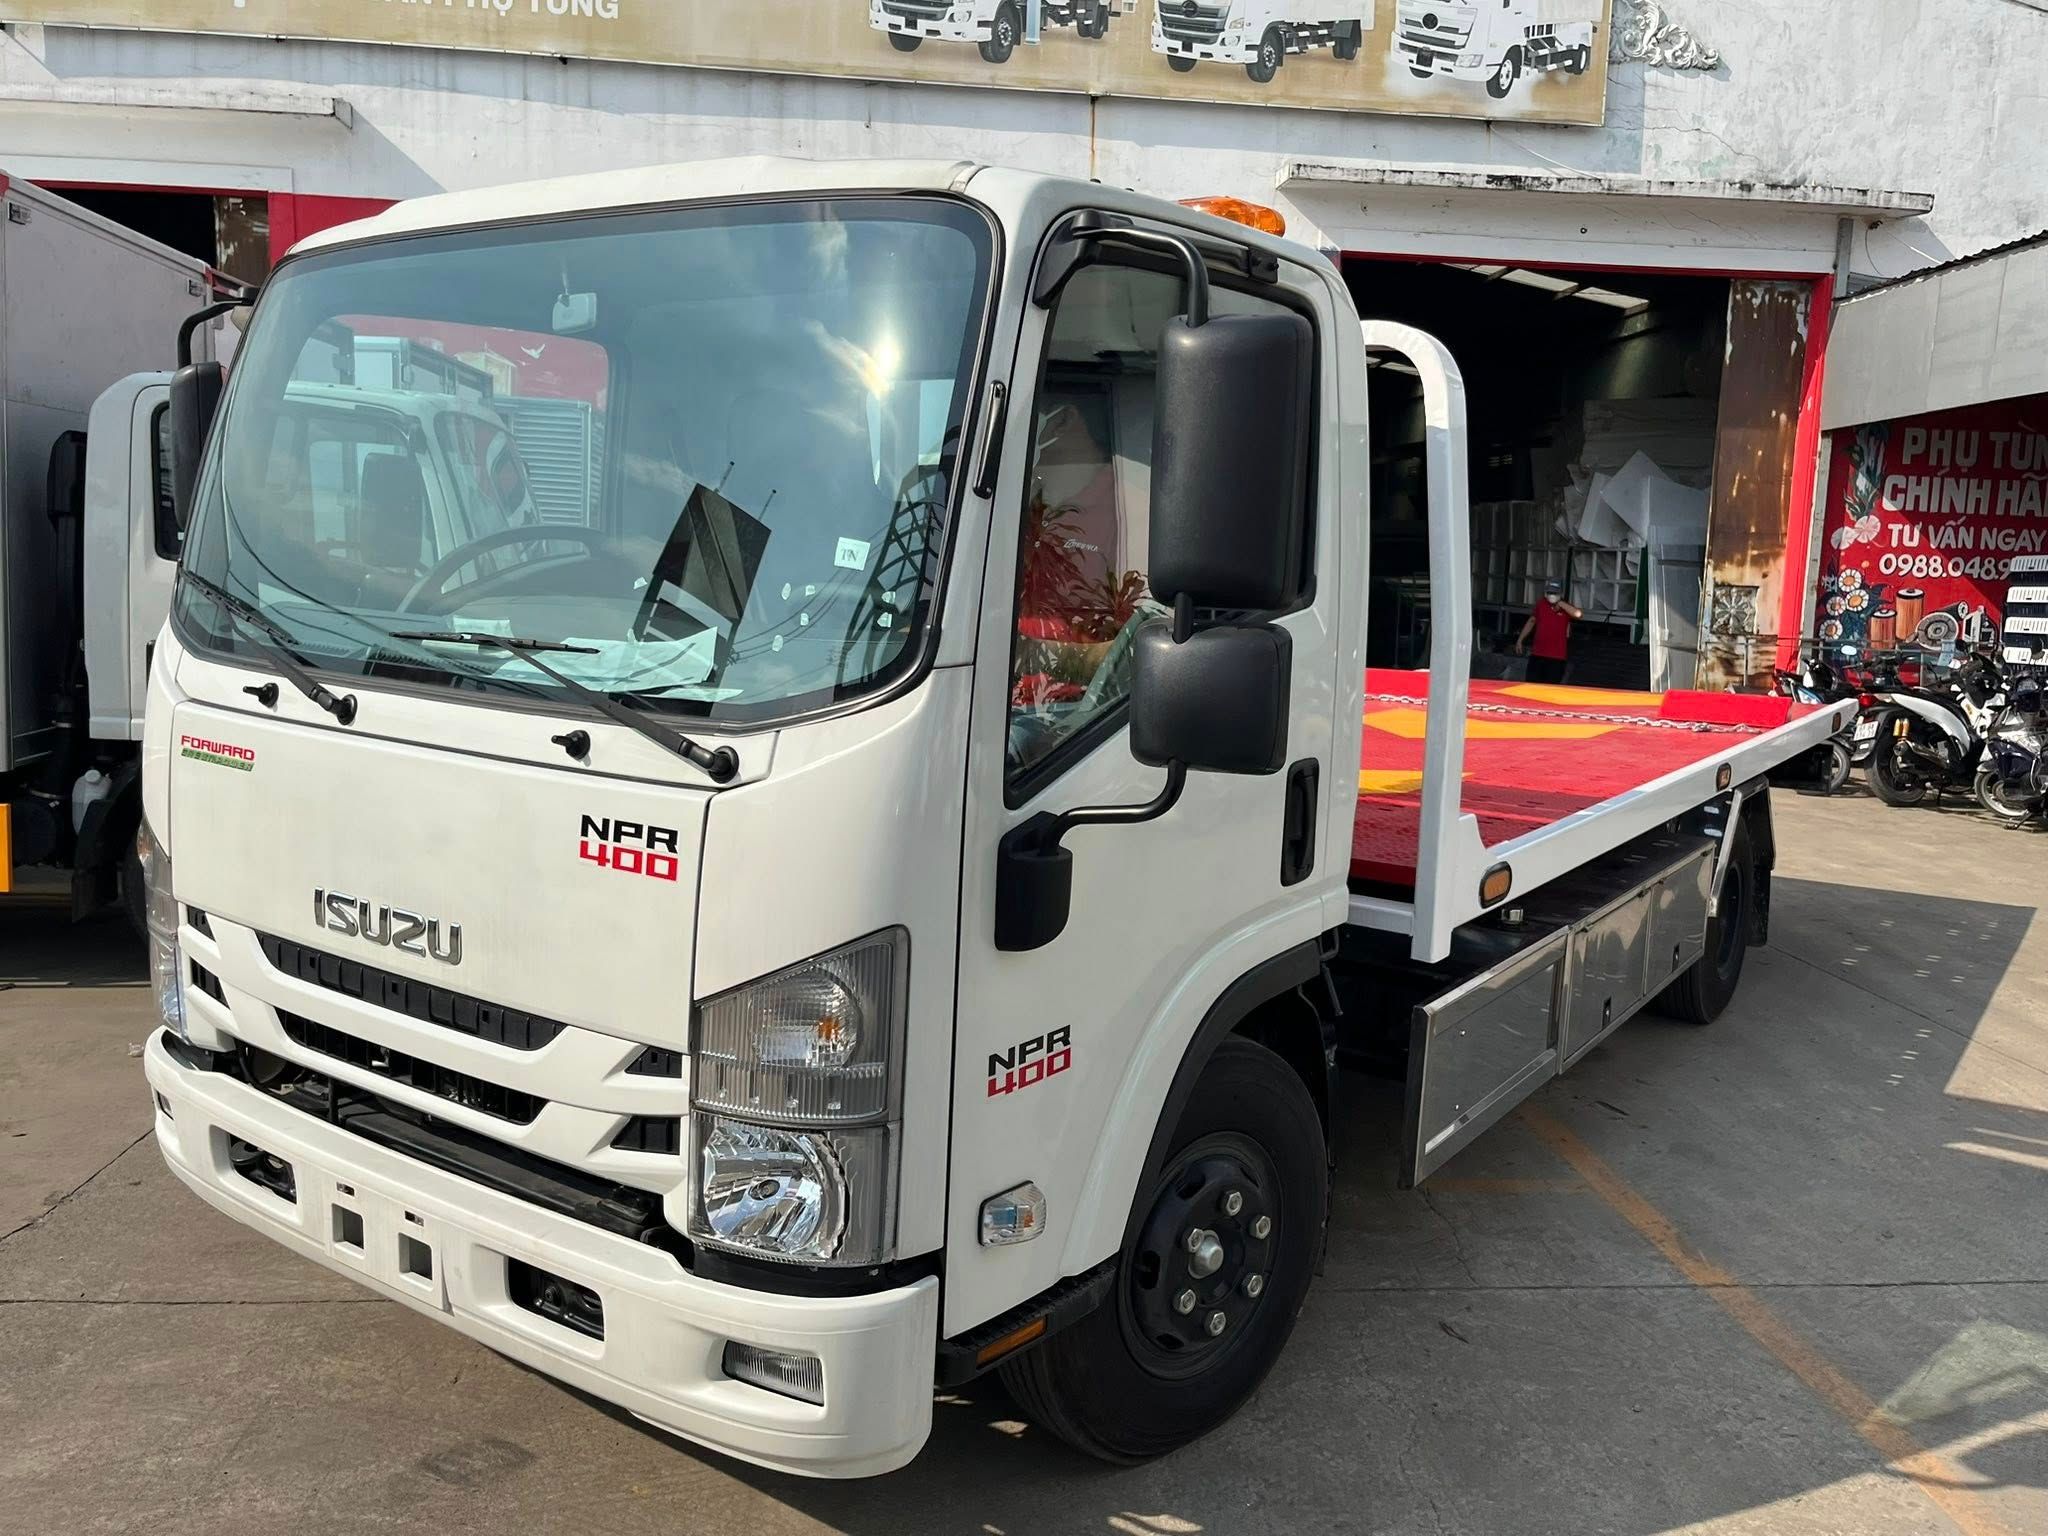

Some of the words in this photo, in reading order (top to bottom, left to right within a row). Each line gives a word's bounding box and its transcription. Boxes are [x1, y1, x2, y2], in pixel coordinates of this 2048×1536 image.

[1902, 427, 1980, 472] PHỤ
[1882, 467, 1992, 516] CHÍNH
[1995, 472, 2048, 518] HÃ
[1928, 516, 1975, 550] VẤN
[1980, 526, 2047, 553] NGAY
[180, 734, 256, 762] FORWARD
[580, 813, 679, 855] NPR
[579, 840, 679, 882] 400
[313, 885, 464, 967] ISUZU
[987, 1047, 1072, 1098] 400
[988, 1024, 1071, 1078] NPR
